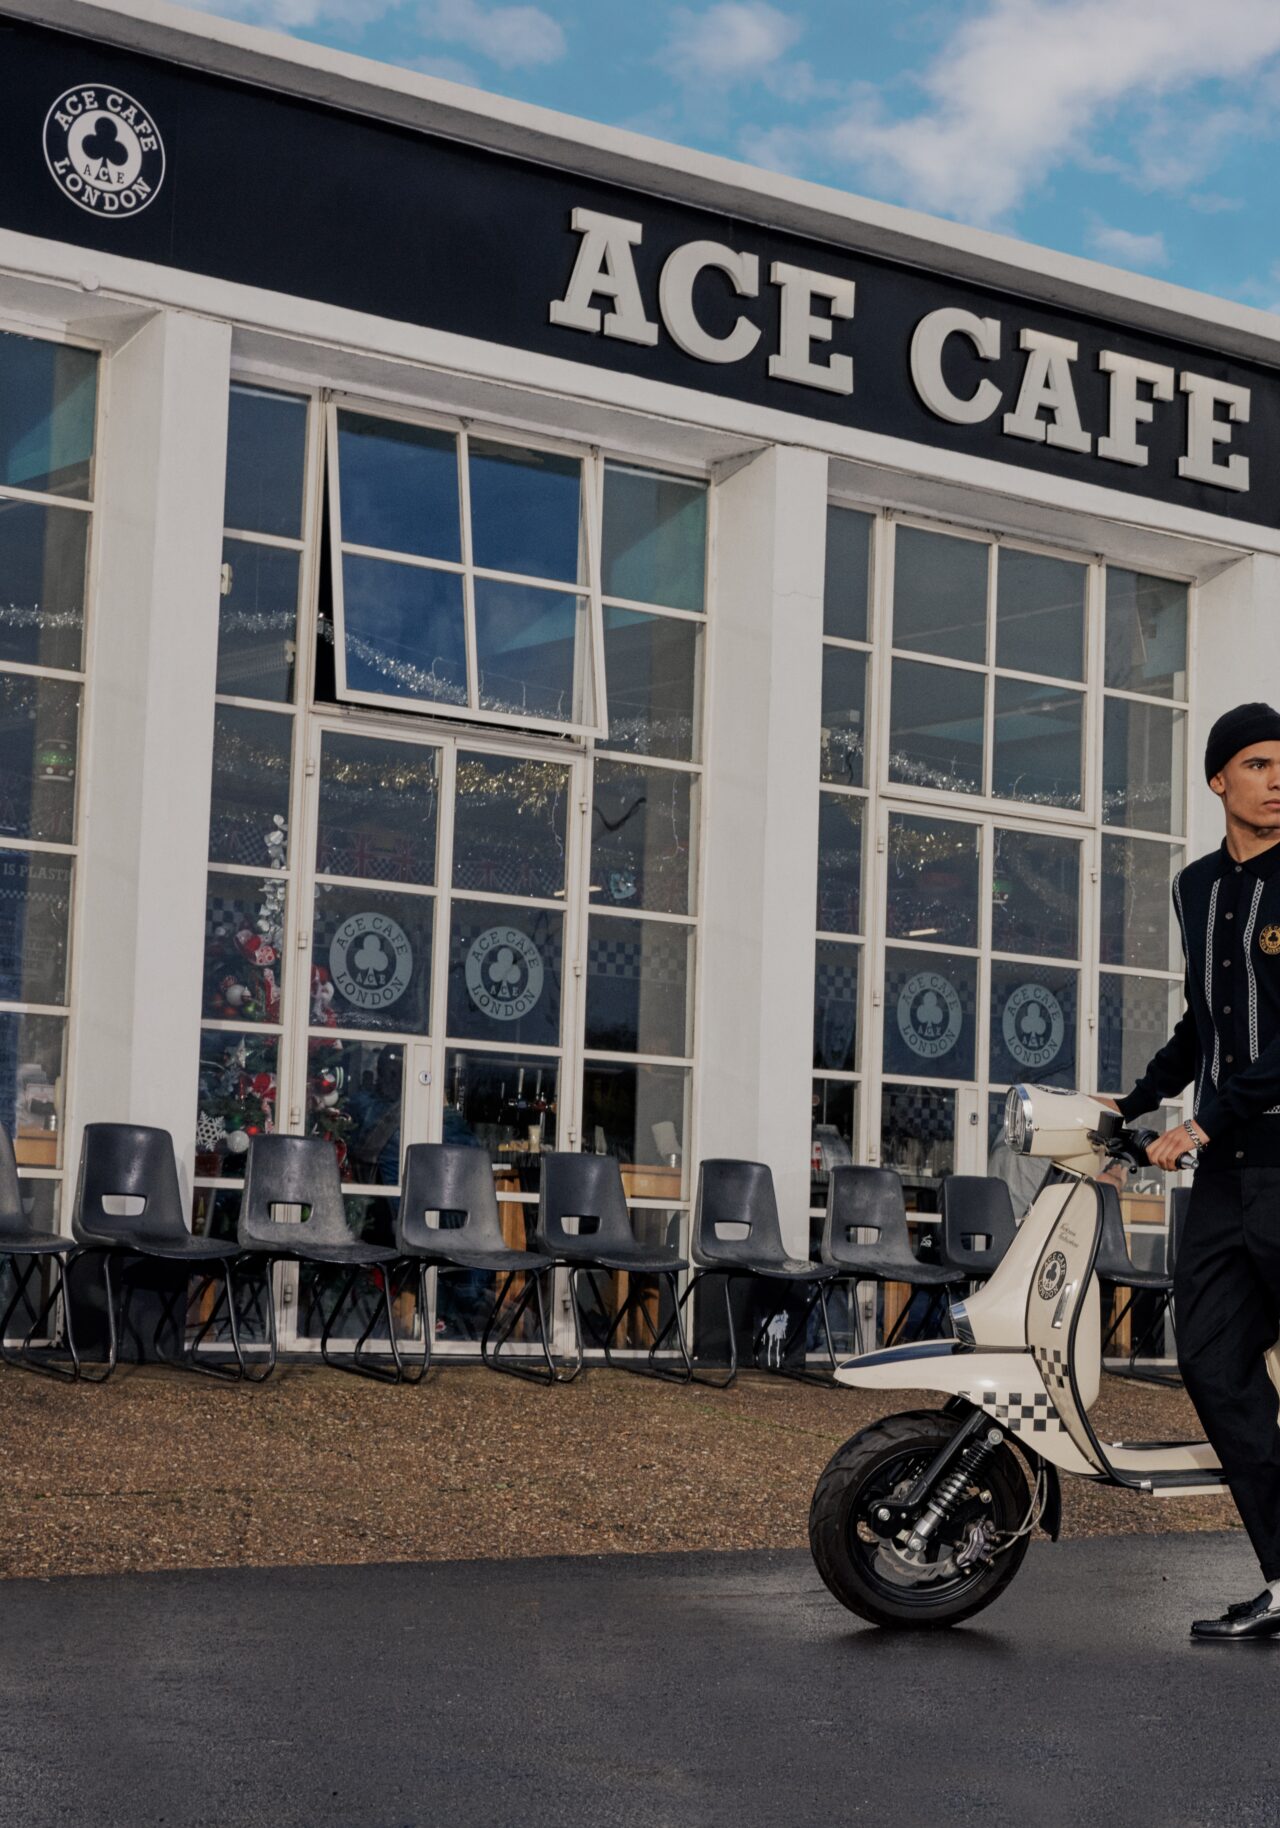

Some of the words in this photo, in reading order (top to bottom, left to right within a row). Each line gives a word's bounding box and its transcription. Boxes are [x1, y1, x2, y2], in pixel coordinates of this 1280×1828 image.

[54, 90, 98, 131] ACE
[106, 94, 158, 152] CAFE
[54, 157, 151, 211] LONDON
[549, 206, 856, 395] ACE
[910, 306, 1251, 493] CAFE
[3, 863, 16, 876] IS
[20, 864, 69, 881] PLASTI
[337, 918, 366, 951] ACE
[372, 917, 409, 955] CAFE
[472, 932, 500, 963] ACE
[506, 931, 539, 969] CAFE
[337, 971, 404, 1005] LONDON
[472, 985, 535, 1017] LONDON
[902, 977, 925, 1006] ACE
[930, 976, 959, 1010] CAFE
[1008, 988, 1028, 1017] ACE
[1033, 987, 1061, 1021] CAFE
[903, 1025, 956, 1055] LONDON
[1008, 1036, 1058, 1065] LONDON
